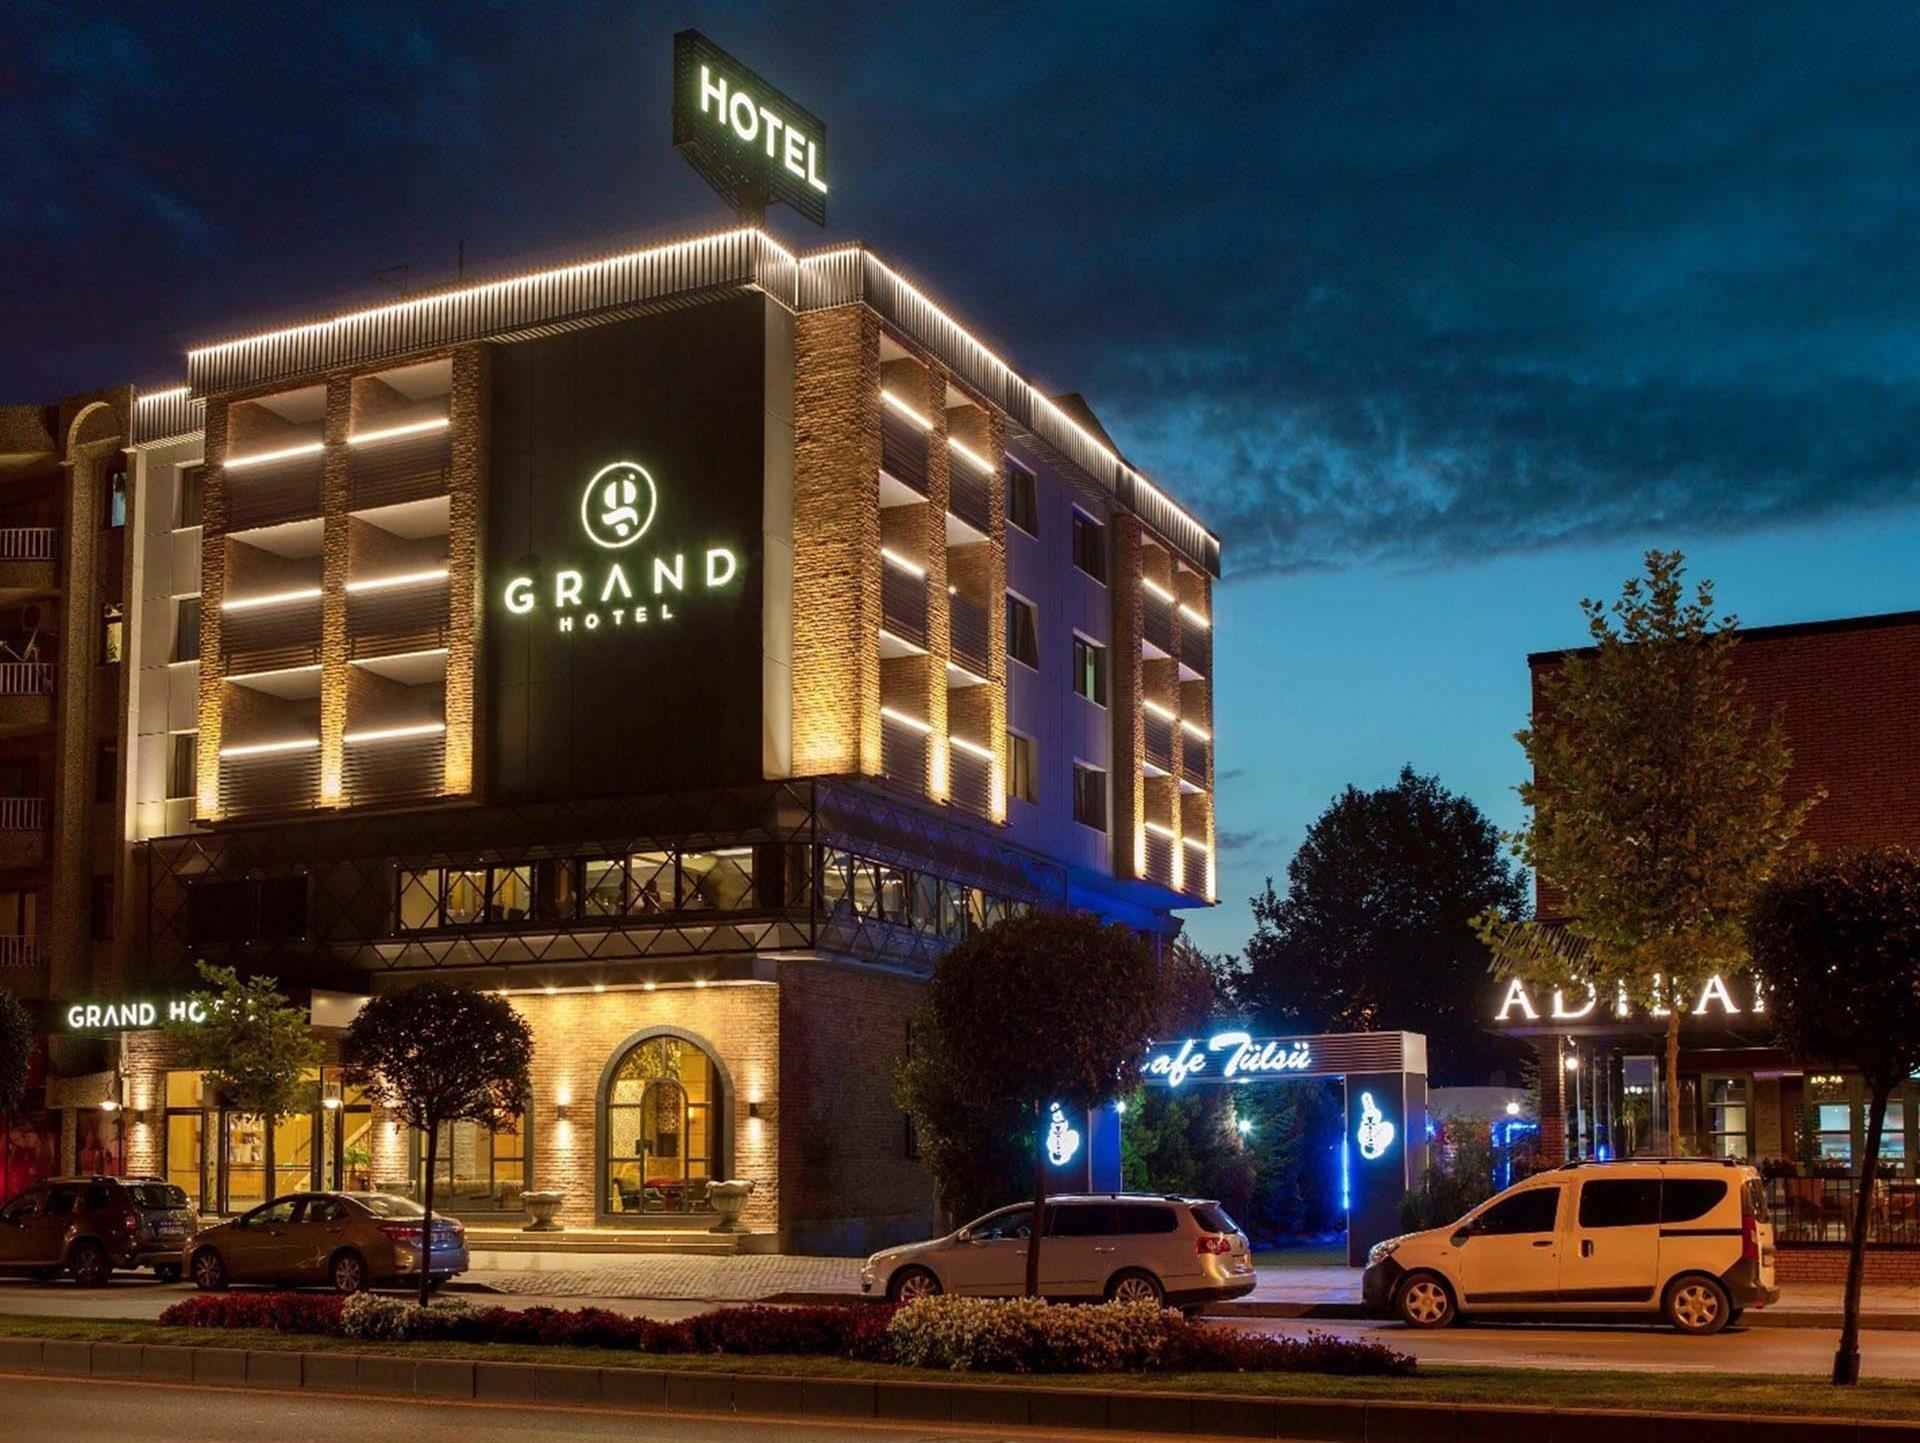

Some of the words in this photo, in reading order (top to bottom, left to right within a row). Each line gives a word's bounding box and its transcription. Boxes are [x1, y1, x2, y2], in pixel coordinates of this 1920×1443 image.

[701, 64, 828, 194] HOTEL
[504, 548, 737, 614] GRAND
[559, 603, 673, 632] HOTEL
[68, 1003, 155, 1028] GRAND
[1138, 1038, 1207, 1088] afe
